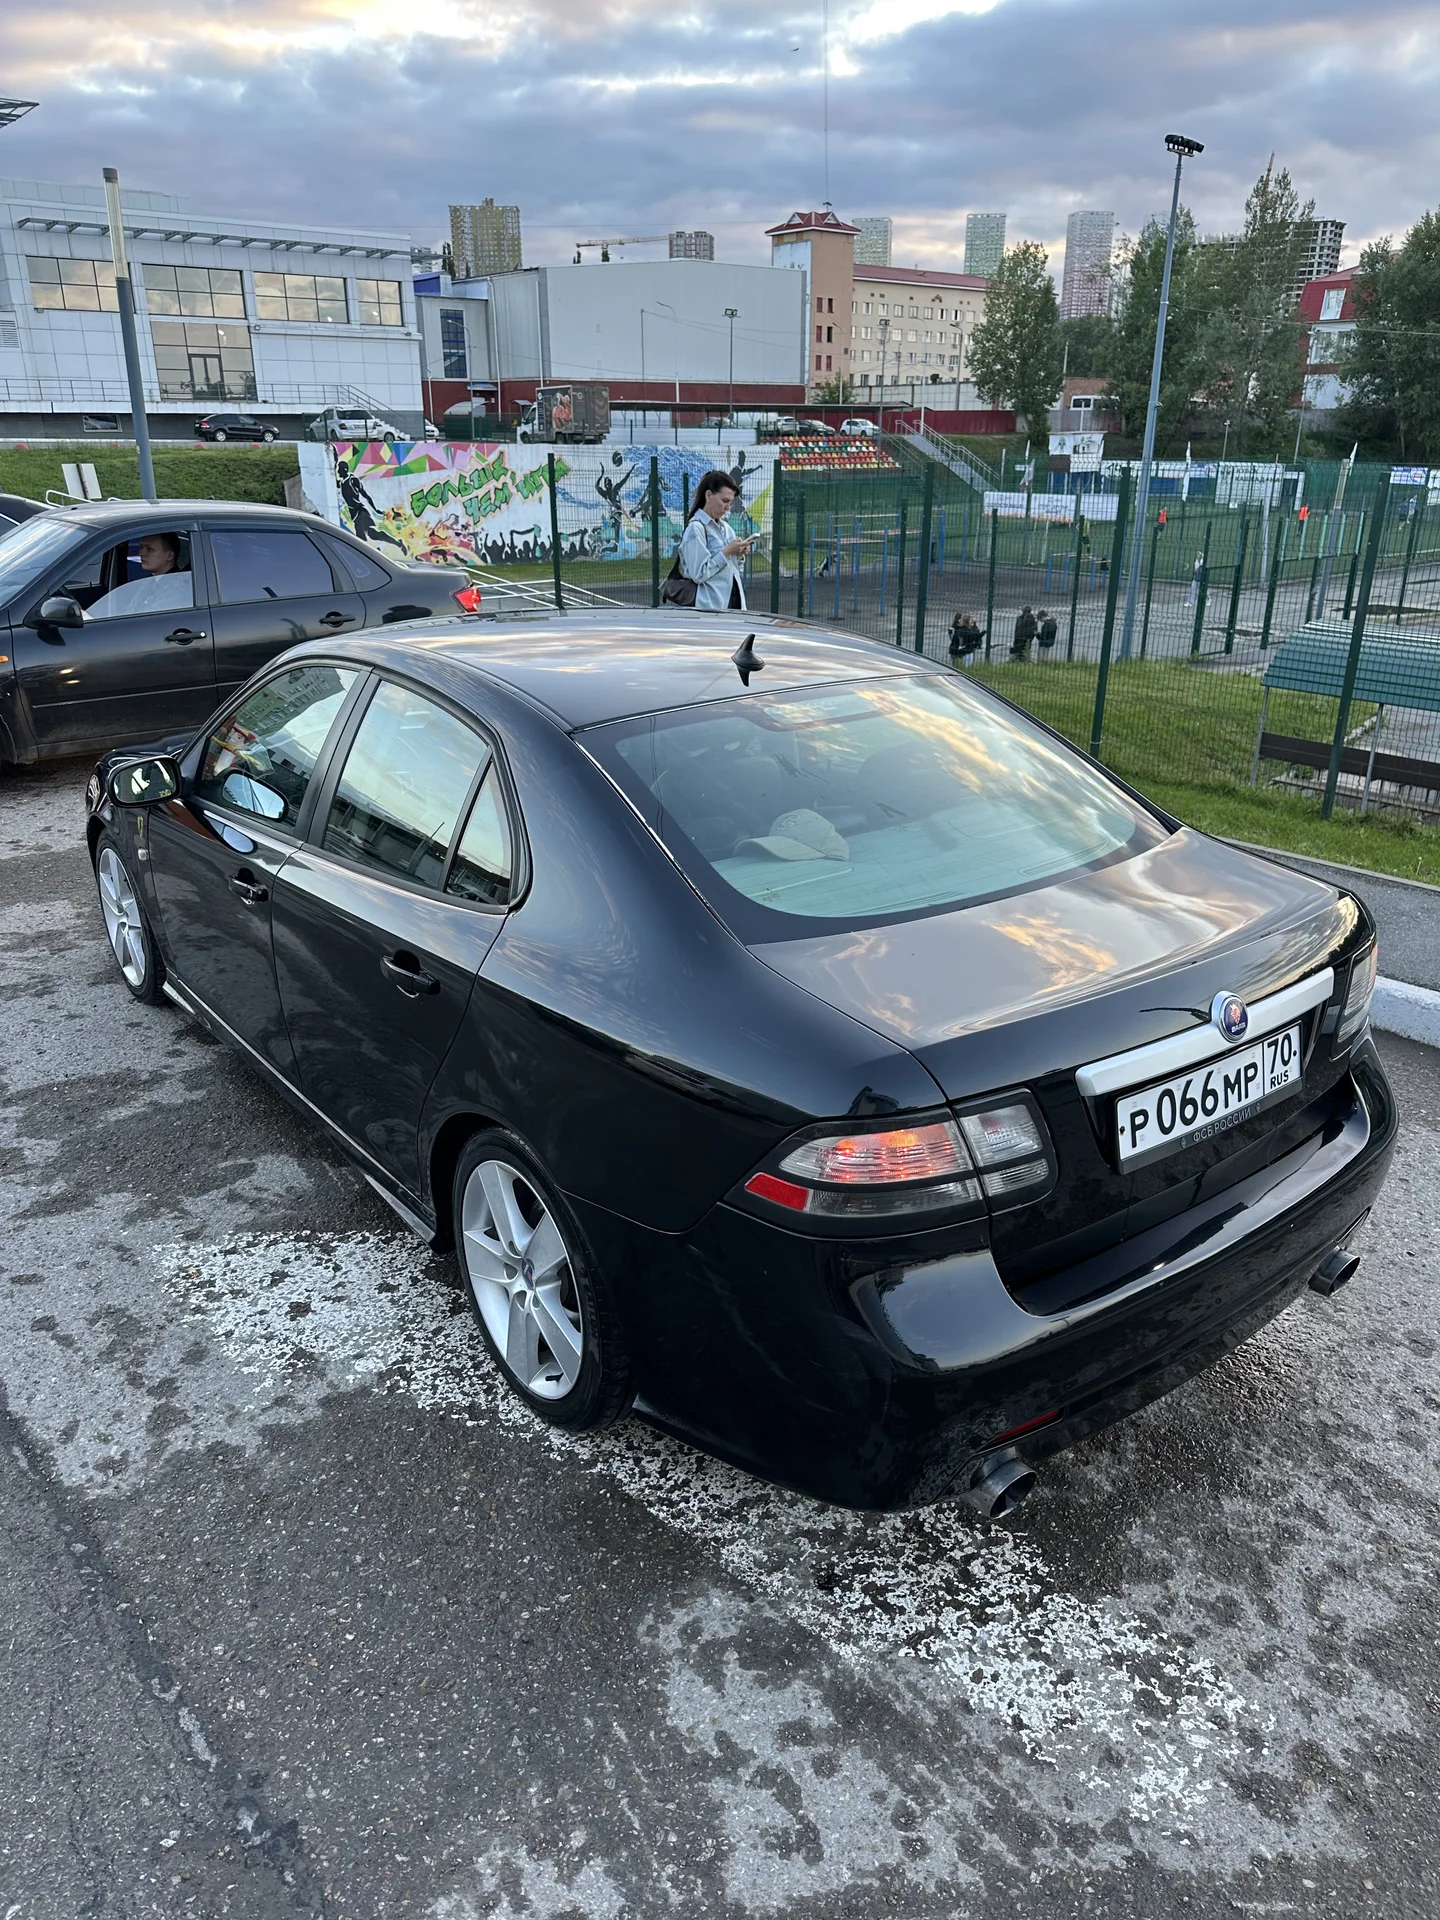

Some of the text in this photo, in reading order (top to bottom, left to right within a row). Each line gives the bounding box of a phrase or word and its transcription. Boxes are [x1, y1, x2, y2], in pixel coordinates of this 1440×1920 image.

[463, 482, 513, 525] ЧЕМ
[1266, 1033, 1292, 1075] 70
[1269, 1068, 1290, 1089] RUS
[1193, 1107, 1251, 1143] ФСБ РОССИИ
